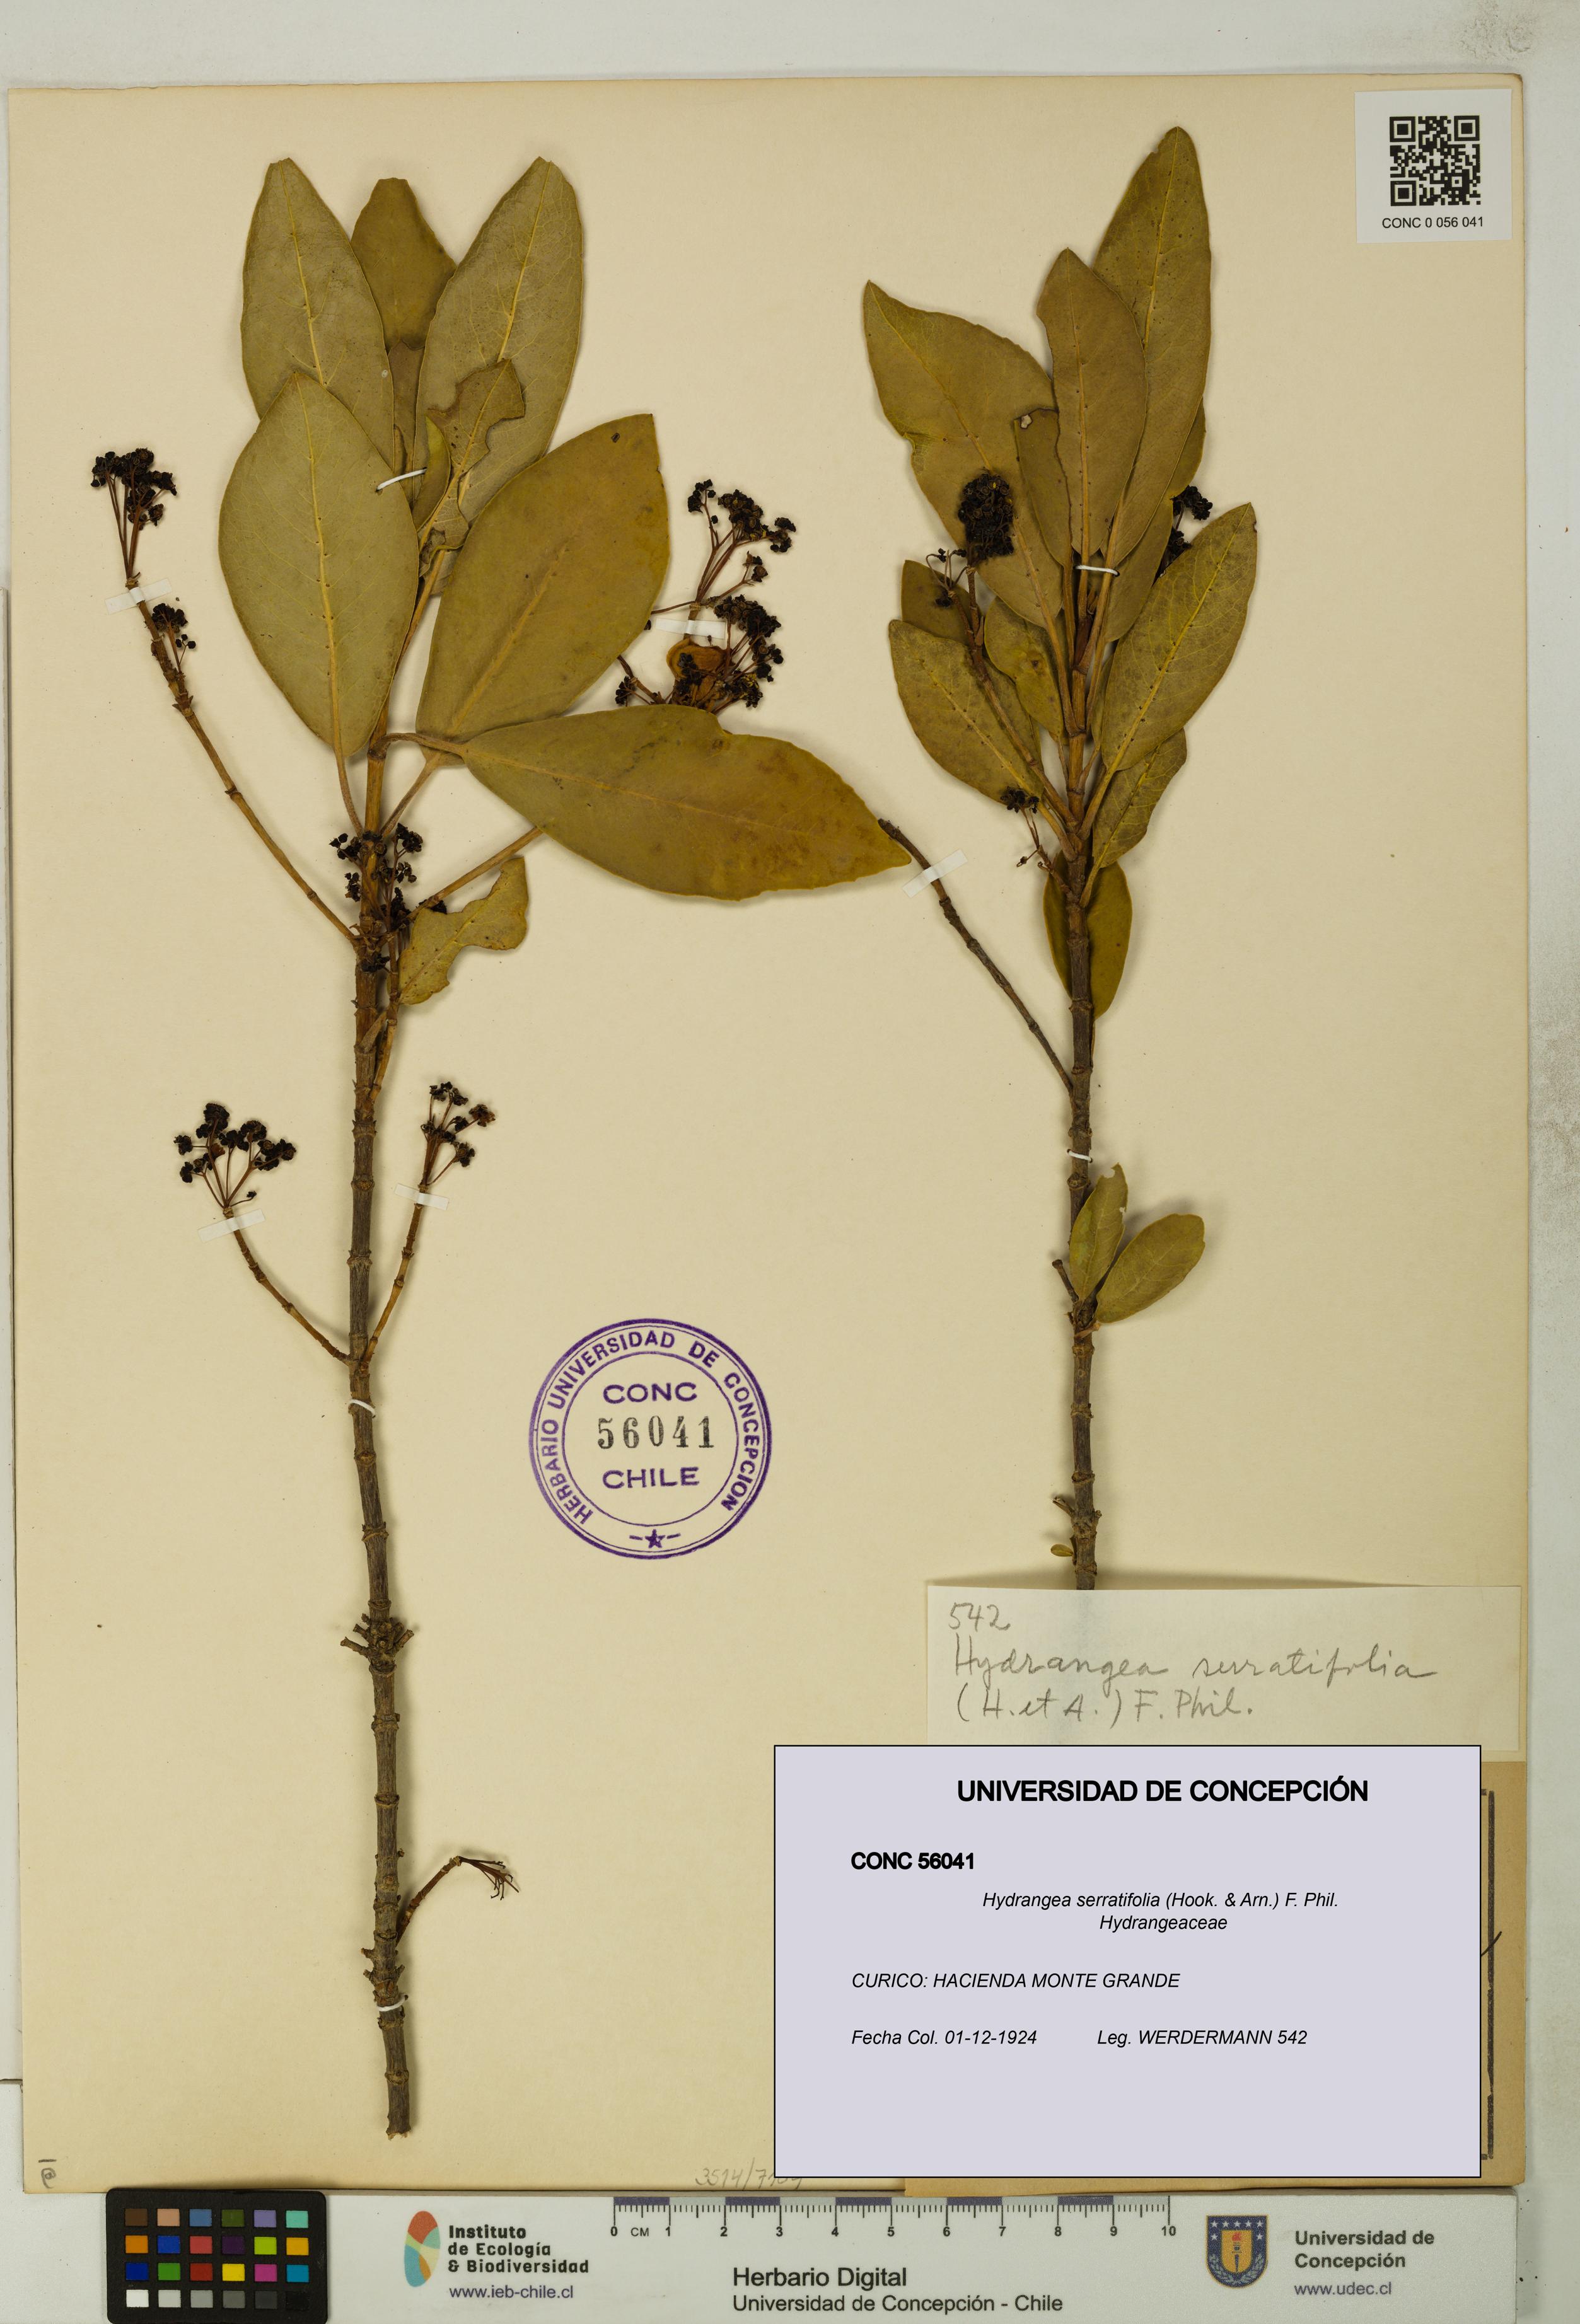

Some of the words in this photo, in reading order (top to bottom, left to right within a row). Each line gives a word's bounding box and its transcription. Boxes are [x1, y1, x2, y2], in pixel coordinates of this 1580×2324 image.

[1381, 217, 1422, 229] CONC
[1425, 217, 1432, 228] 0
[1436, 216, 1458, 228] 056
[1461, 216, 1484, 228] 041
[688, 1340, 720, 1368] DE
[547, 1330, 675, 1410] UNIVERSIDAD
[602, 1382, 698, 1404] CONC
[597, 1415, 715, 1450] 56041
[721, 1372, 760, 1512] CONCEPCION
[541, 1418, 594, 1525] HERBARIO
[602, 1466, 700, 1489] CHILE
[948, 1602, 1011, 1633] 542
[955, 1632, 1170, 1698] Hydrangea
[1192, 1642, 1438, 1689] serratifolia
[1134, 1688, 1164, 1722] F.
[1174, 1685, 1253, 1720] Phil.
[448, 2224, 526, 2240] Instituto
[610, 2226, 619, 2238] 0
[630, 2226, 649, 2238] CM
[665, 2226, 671, 2238] 1
[719, 2226, 728, 2238] 2
[775, 2226, 784, 2238] 3
[831, 2226, 839, 2238] 4
[887, 2226, 895, 2238] 5
[943, 2226, 951, 2238] 6
[998, 2226, 1007, 2238] 7
[1054, 2226, 1062, 2238] 8
[1110, 2226, 1118, 2238] 9
[1161, 2226, 1176, 2238] 10
[1295, 2229, 1407, 2246] Universidad
[1412, 2229, 1435, 2246] de
[448, 2242, 469, 2257] de
[475, 2241, 551, 2259] Ecología
[448, 2259, 460, 2273] &
[467, 2258, 589, 2274] Biodiversidad
[1294, 2252, 1406, 2272] Concepción
[733, 2267, 830, 2287] Herbario
[837, 2267, 907, 2292] Digital
[1294, 2281, 1392, 2296] www.udec.cl
[449, 2284, 574, 2299] www.ieb-chile.cl
[733, 2294, 845, 2312] Universidad
[852, 2294, 876, 2312] de
[881, 2294, 995, 2316] Concepción
[1014, 2294, 1063, 2312] Chile
